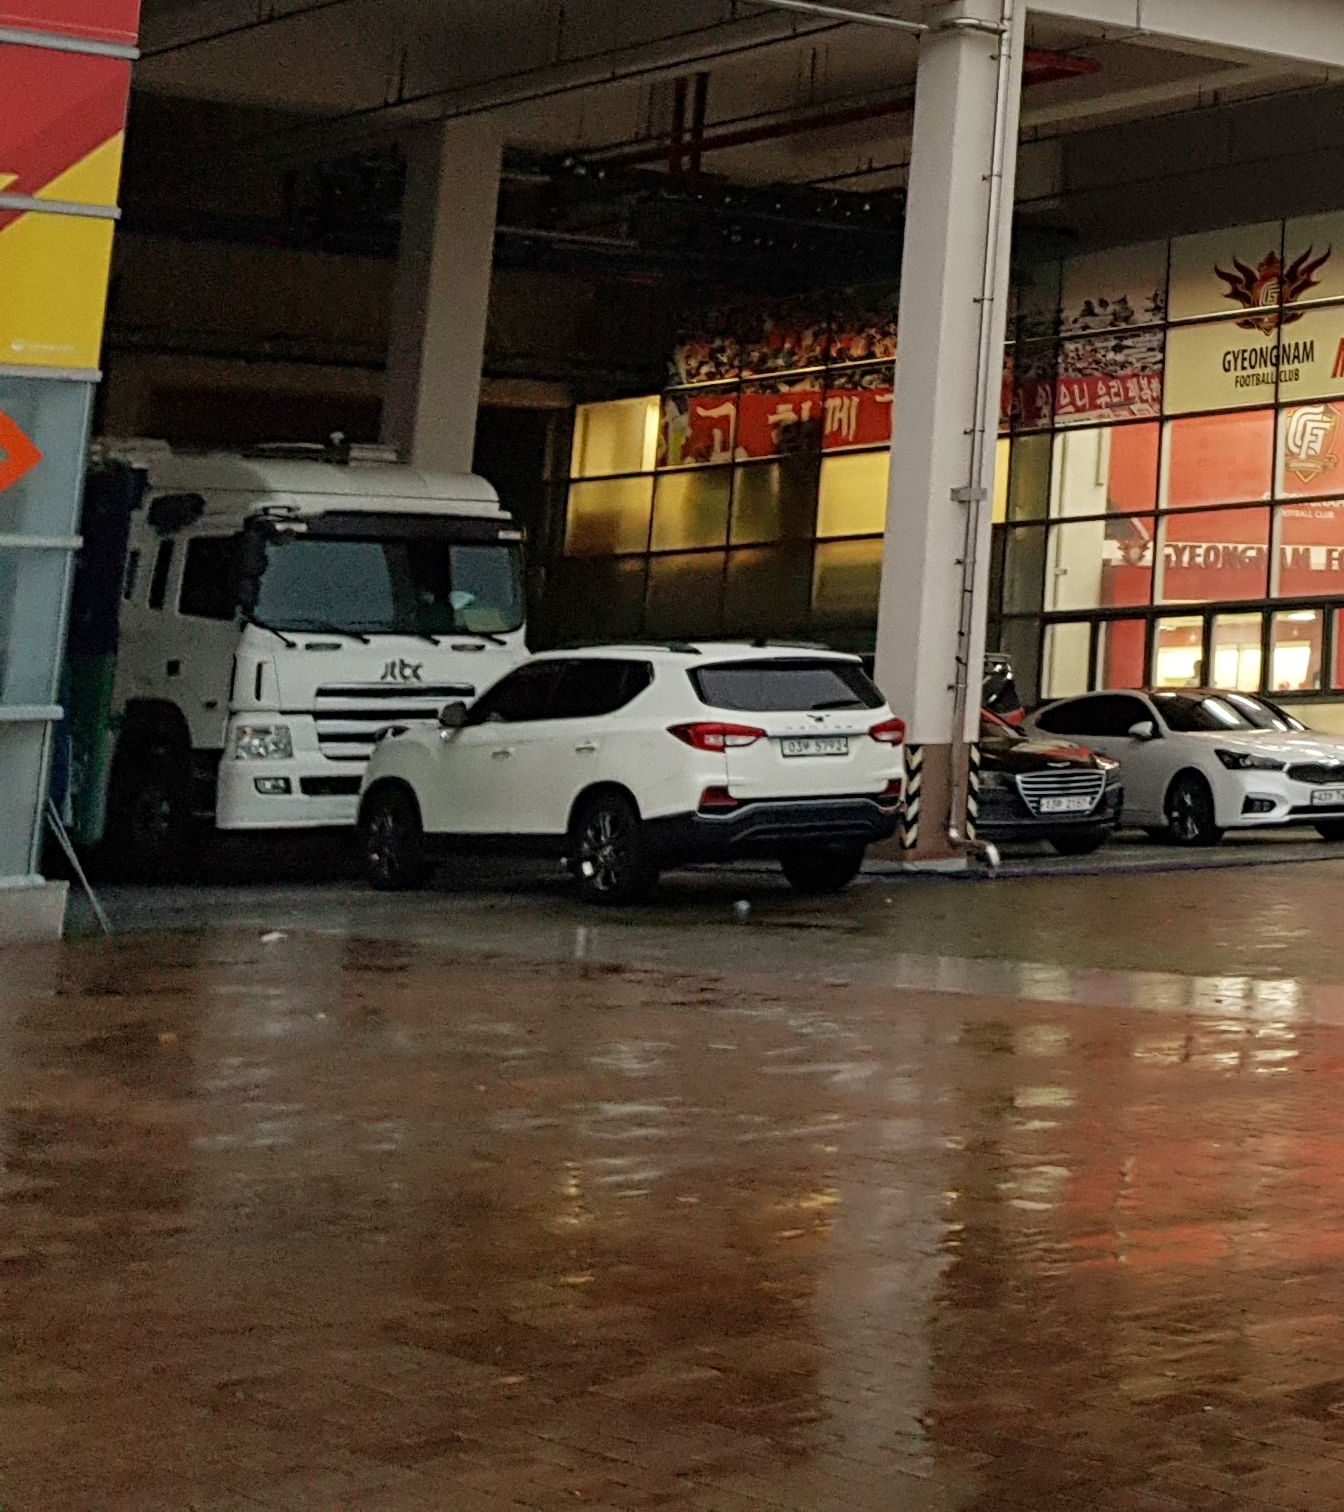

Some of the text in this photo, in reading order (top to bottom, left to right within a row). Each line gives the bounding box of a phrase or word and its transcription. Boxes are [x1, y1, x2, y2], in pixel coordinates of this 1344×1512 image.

[1222, 340, 1315, 373] GYEONGNAM
[1234, 368, 1300, 389] FOOTBALL CLUB
